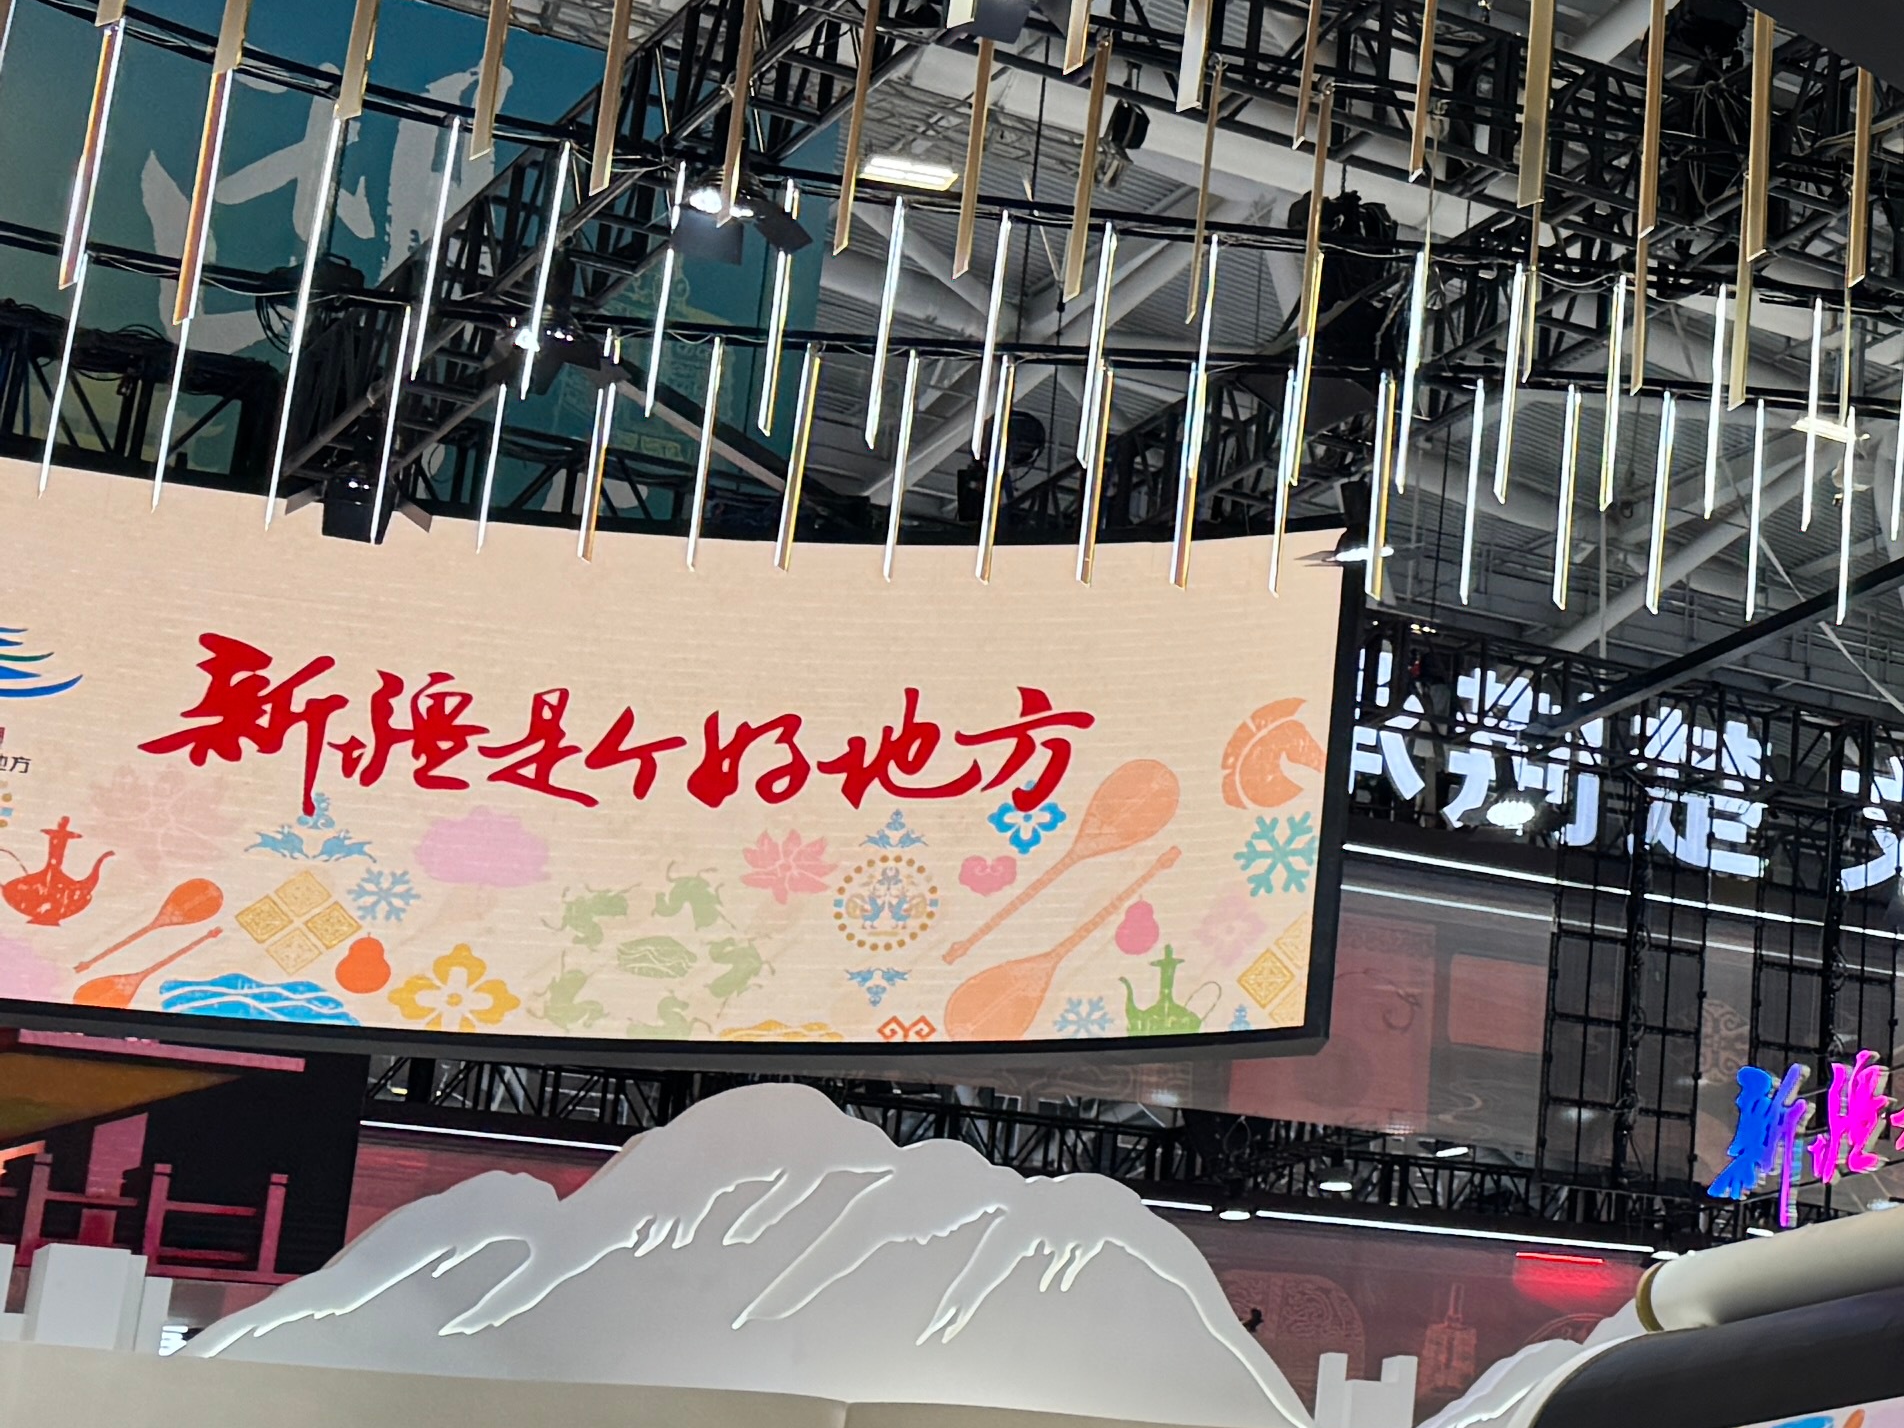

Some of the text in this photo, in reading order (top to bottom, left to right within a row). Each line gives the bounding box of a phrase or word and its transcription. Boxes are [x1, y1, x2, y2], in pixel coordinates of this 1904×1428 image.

[138, 632, 1096, 815] 新疆是个好地方
